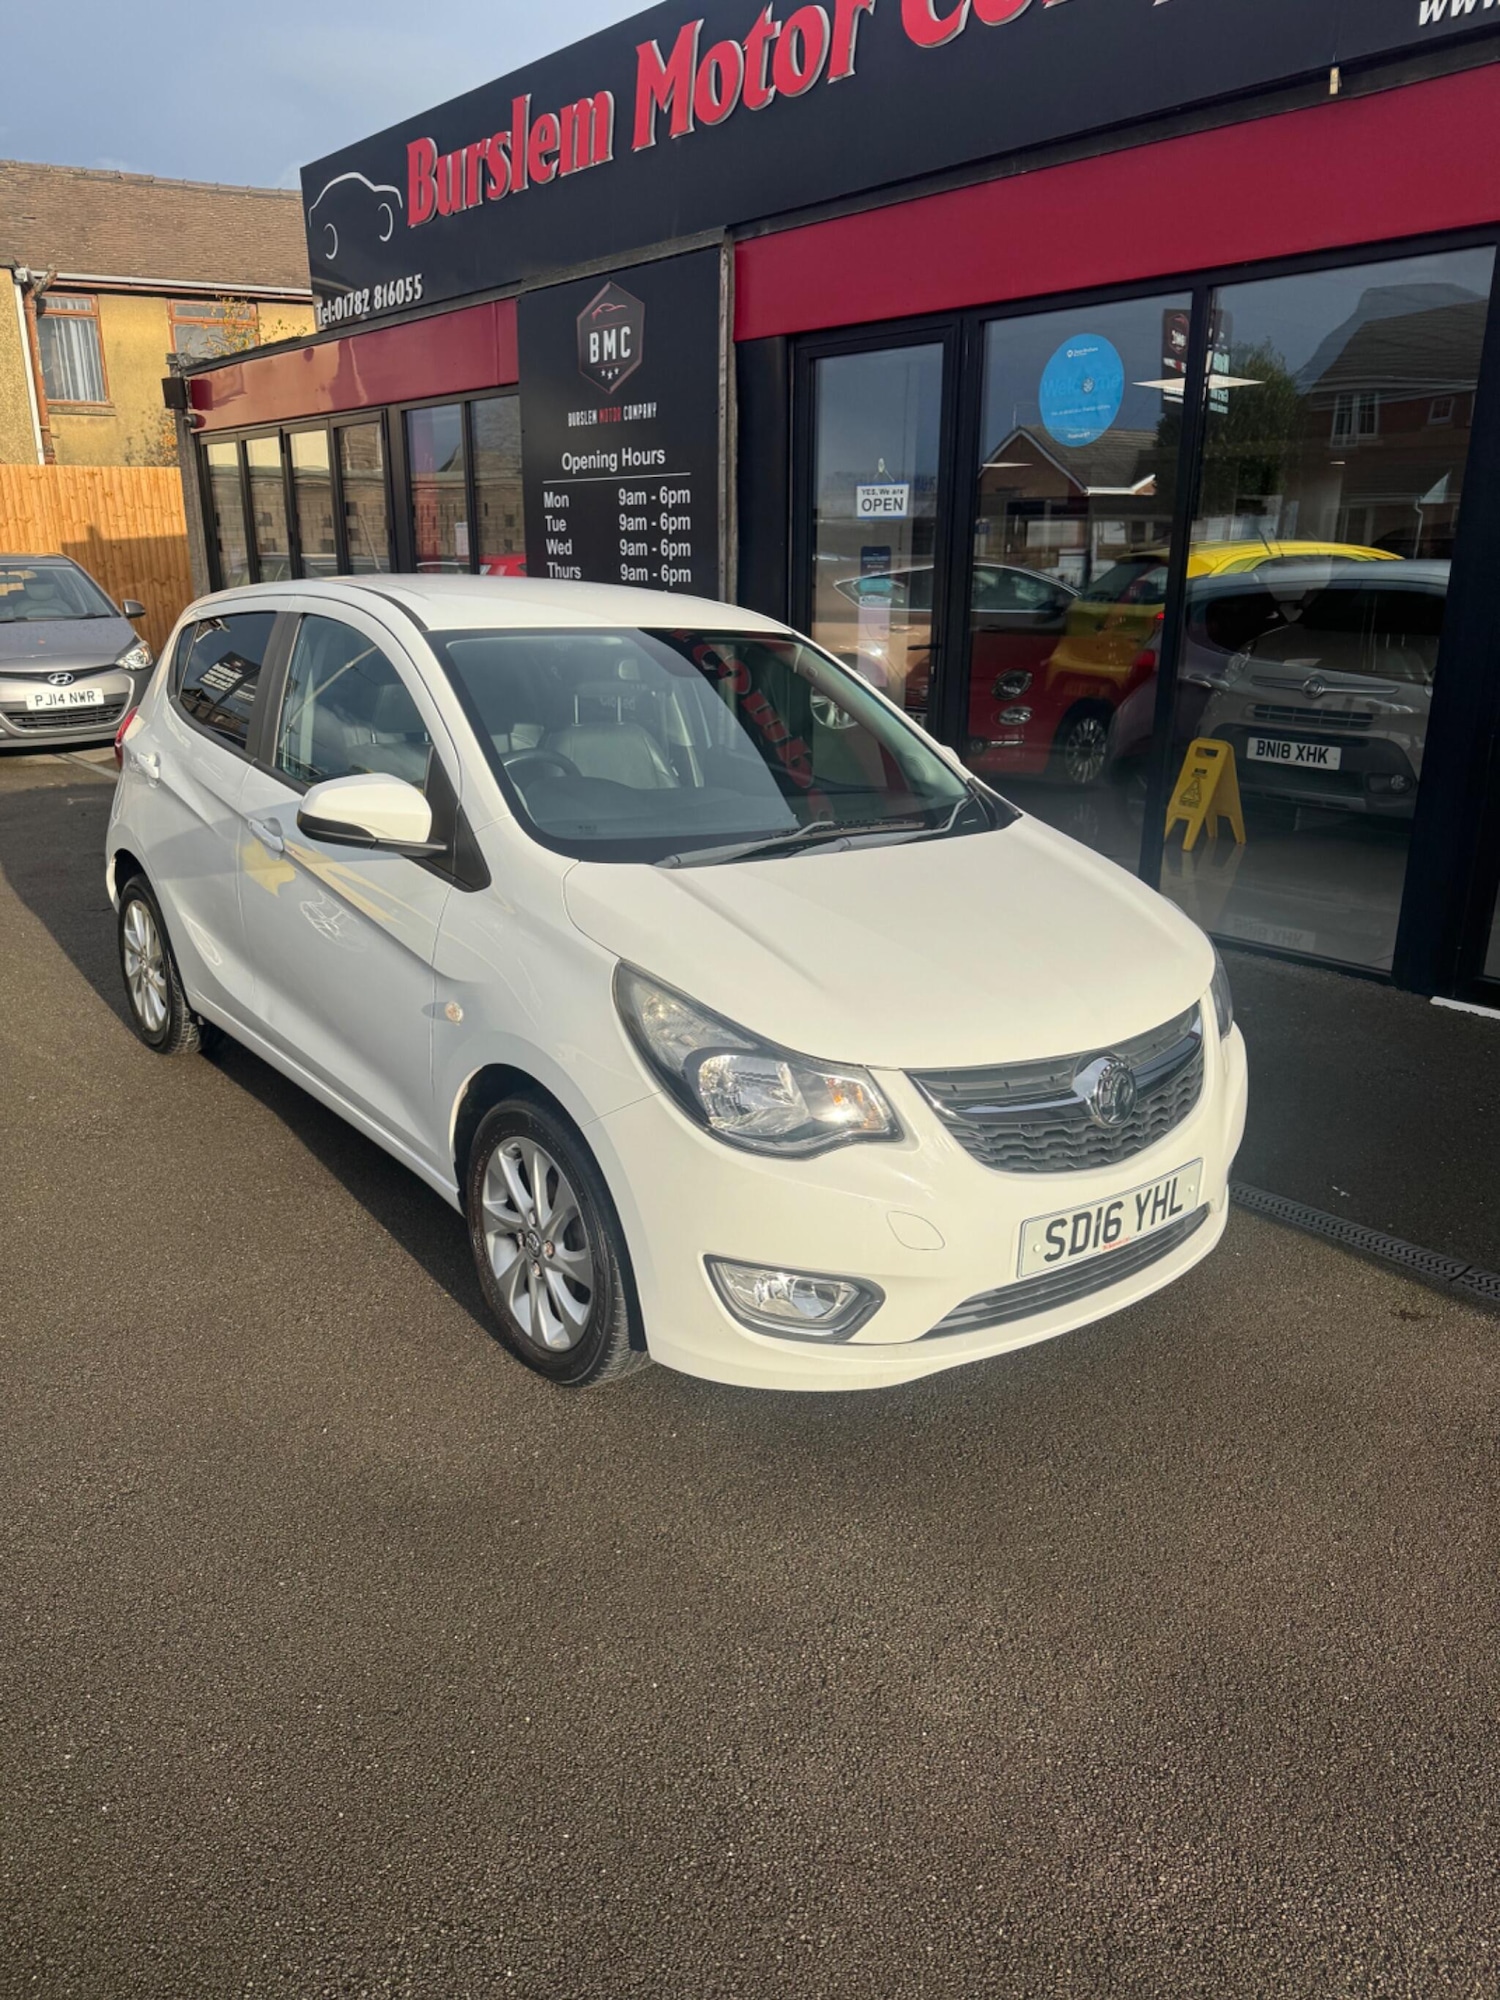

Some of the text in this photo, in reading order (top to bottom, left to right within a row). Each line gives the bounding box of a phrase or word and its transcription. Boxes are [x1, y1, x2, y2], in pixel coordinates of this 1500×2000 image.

[406, 0, 876, 229] Burslem Motor
[316, 273, 423, 325] Tel:01782 816055
[589, 326, 632, 364] BMC
[568, 402, 657, 427] BURSLEM MOTOR COMPANY
[562, 447, 666, 474] Opening Hours
[543, 491, 569, 509] Mon
[618, 488, 647, 506] 9am
[660, 486, 691, 508] 6pm
[861, 497, 904, 512] OPEN
[545, 515, 567, 532] Tue
[619, 513, 647, 531] 9am
[660, 512, 691, 535] 6pm
[546, 538, 572, 556] Wed
[619, 539, 648, 556] 9am
[660, 537, 691, 561] 6pm
[547, 561, 582, 580] Thurs
[620, 564, 648, 582] 9am
[661, 563, 692, 586] 6pm
[34, 690, 95, 707] PJ14 NWR
[1256, 740, 1329, 764] BN18 XHK
[1044, 1177, 1183, 1262] SD16 YHL
